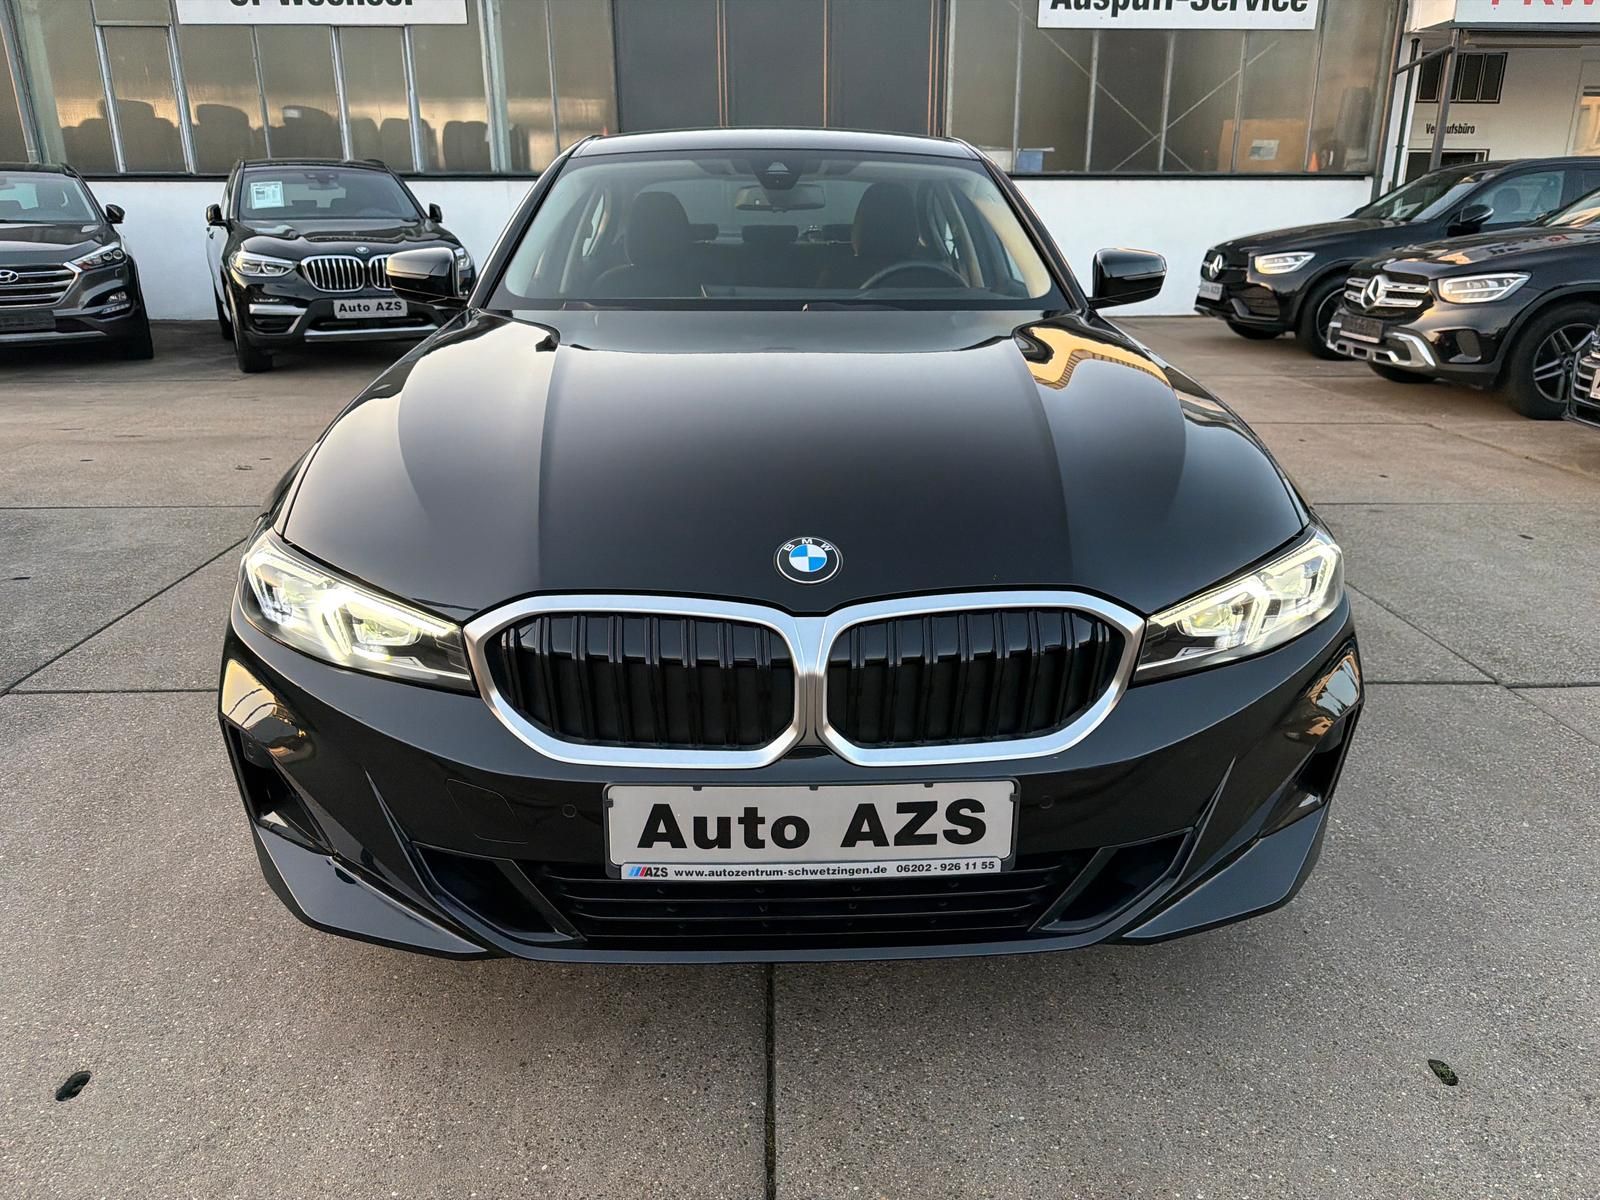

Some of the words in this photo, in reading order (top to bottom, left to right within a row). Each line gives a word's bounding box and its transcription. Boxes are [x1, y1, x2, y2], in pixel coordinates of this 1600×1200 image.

[1426, 123, 1475, 134] Veufsbüro
[338, 303, 371, 313] Auto
[376, 301, 403, 311] AZS
[783, 537, 833, 552] BMW
[636, 803, 811, 850] Auto
[840, 798, 987, 848] AZS
[643, 867, 669, 878] AZS
[673, 865, 888, 877] www.autozentrum-schwetzingen.de
[896, 864, 932, 873] 06202
[939, 862, 961, 871] 926
[964, 861, 977, 870] 11
[980, 860, 995, 869] 55
